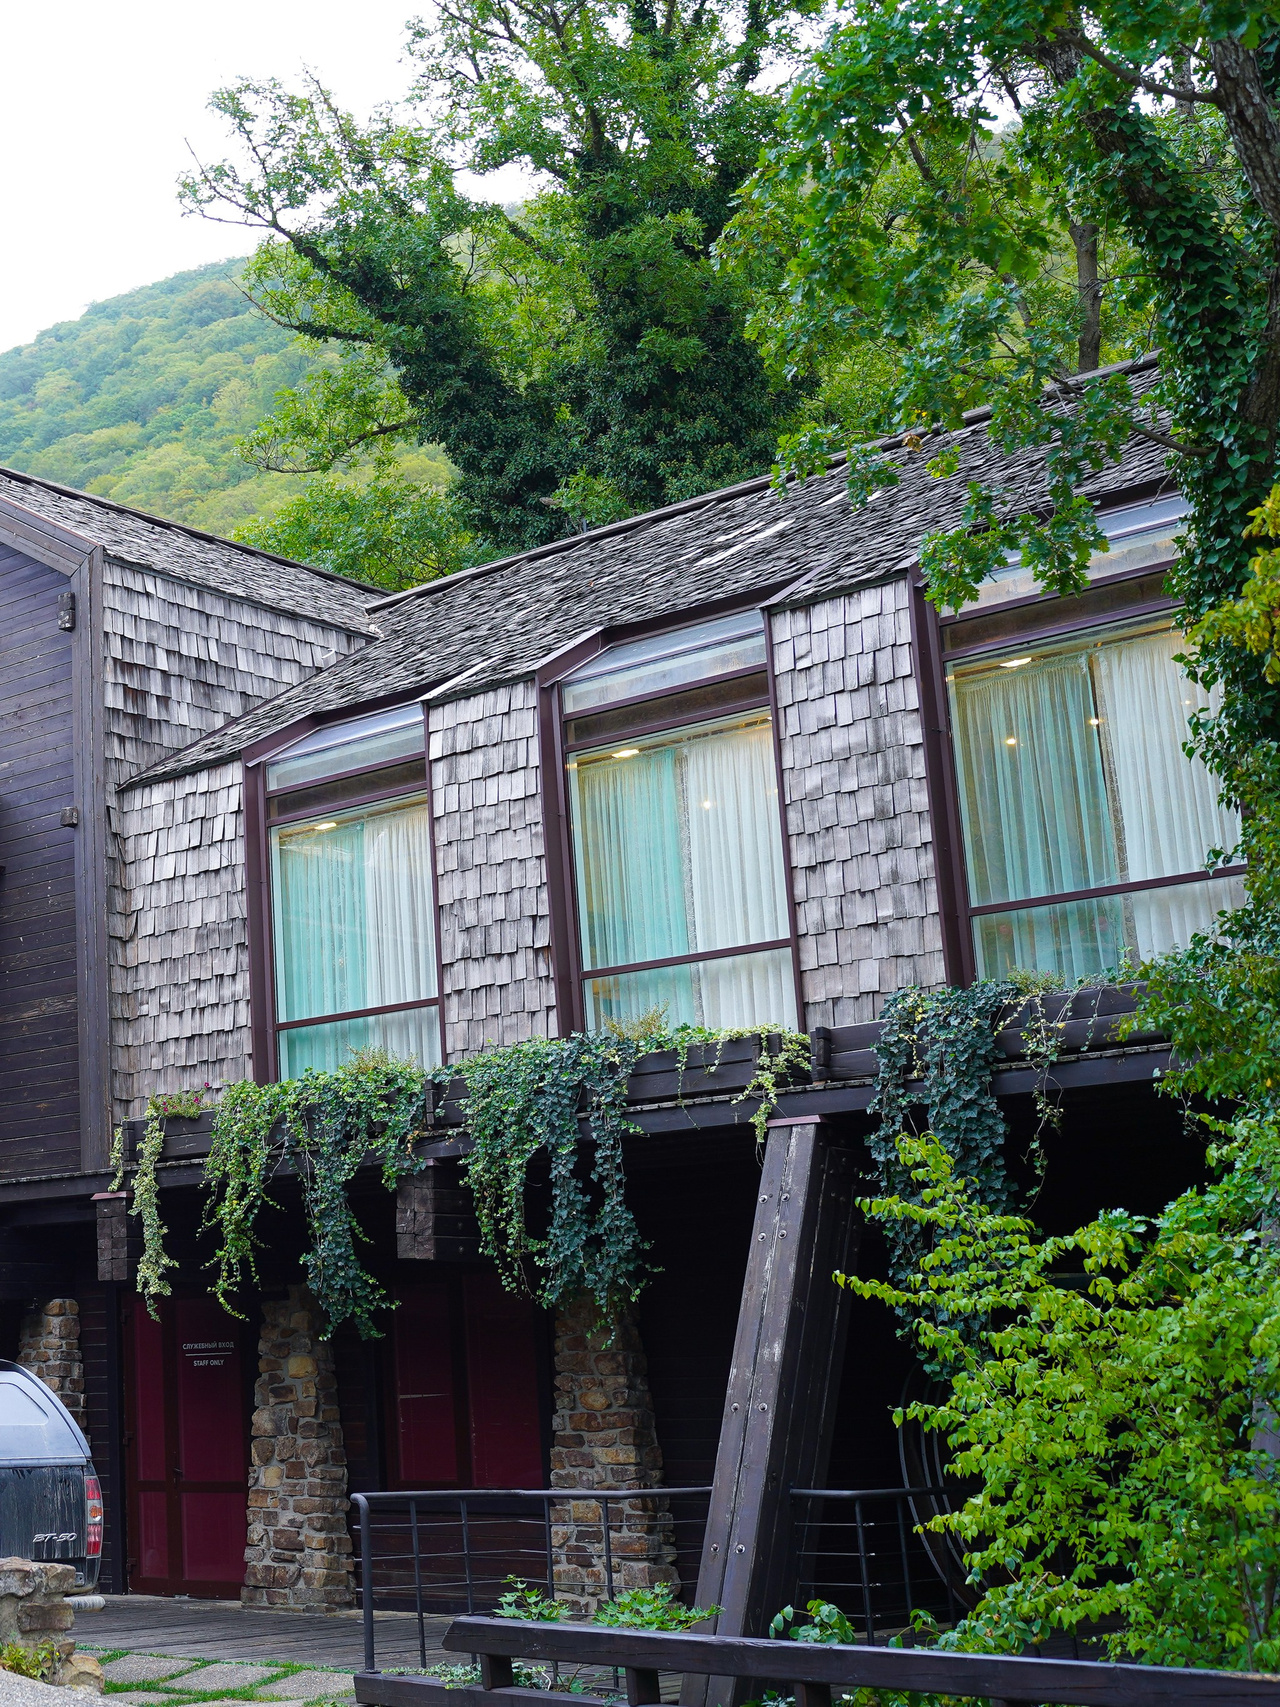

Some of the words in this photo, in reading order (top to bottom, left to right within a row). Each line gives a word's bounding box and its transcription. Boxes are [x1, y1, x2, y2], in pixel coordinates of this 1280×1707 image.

[182, 1341, 218, 1350] СЛУЖЕБНЫЙ
[218, 1341, 234, 1349] ВХОД
[32, 1532, 77, 1543] BT-50
